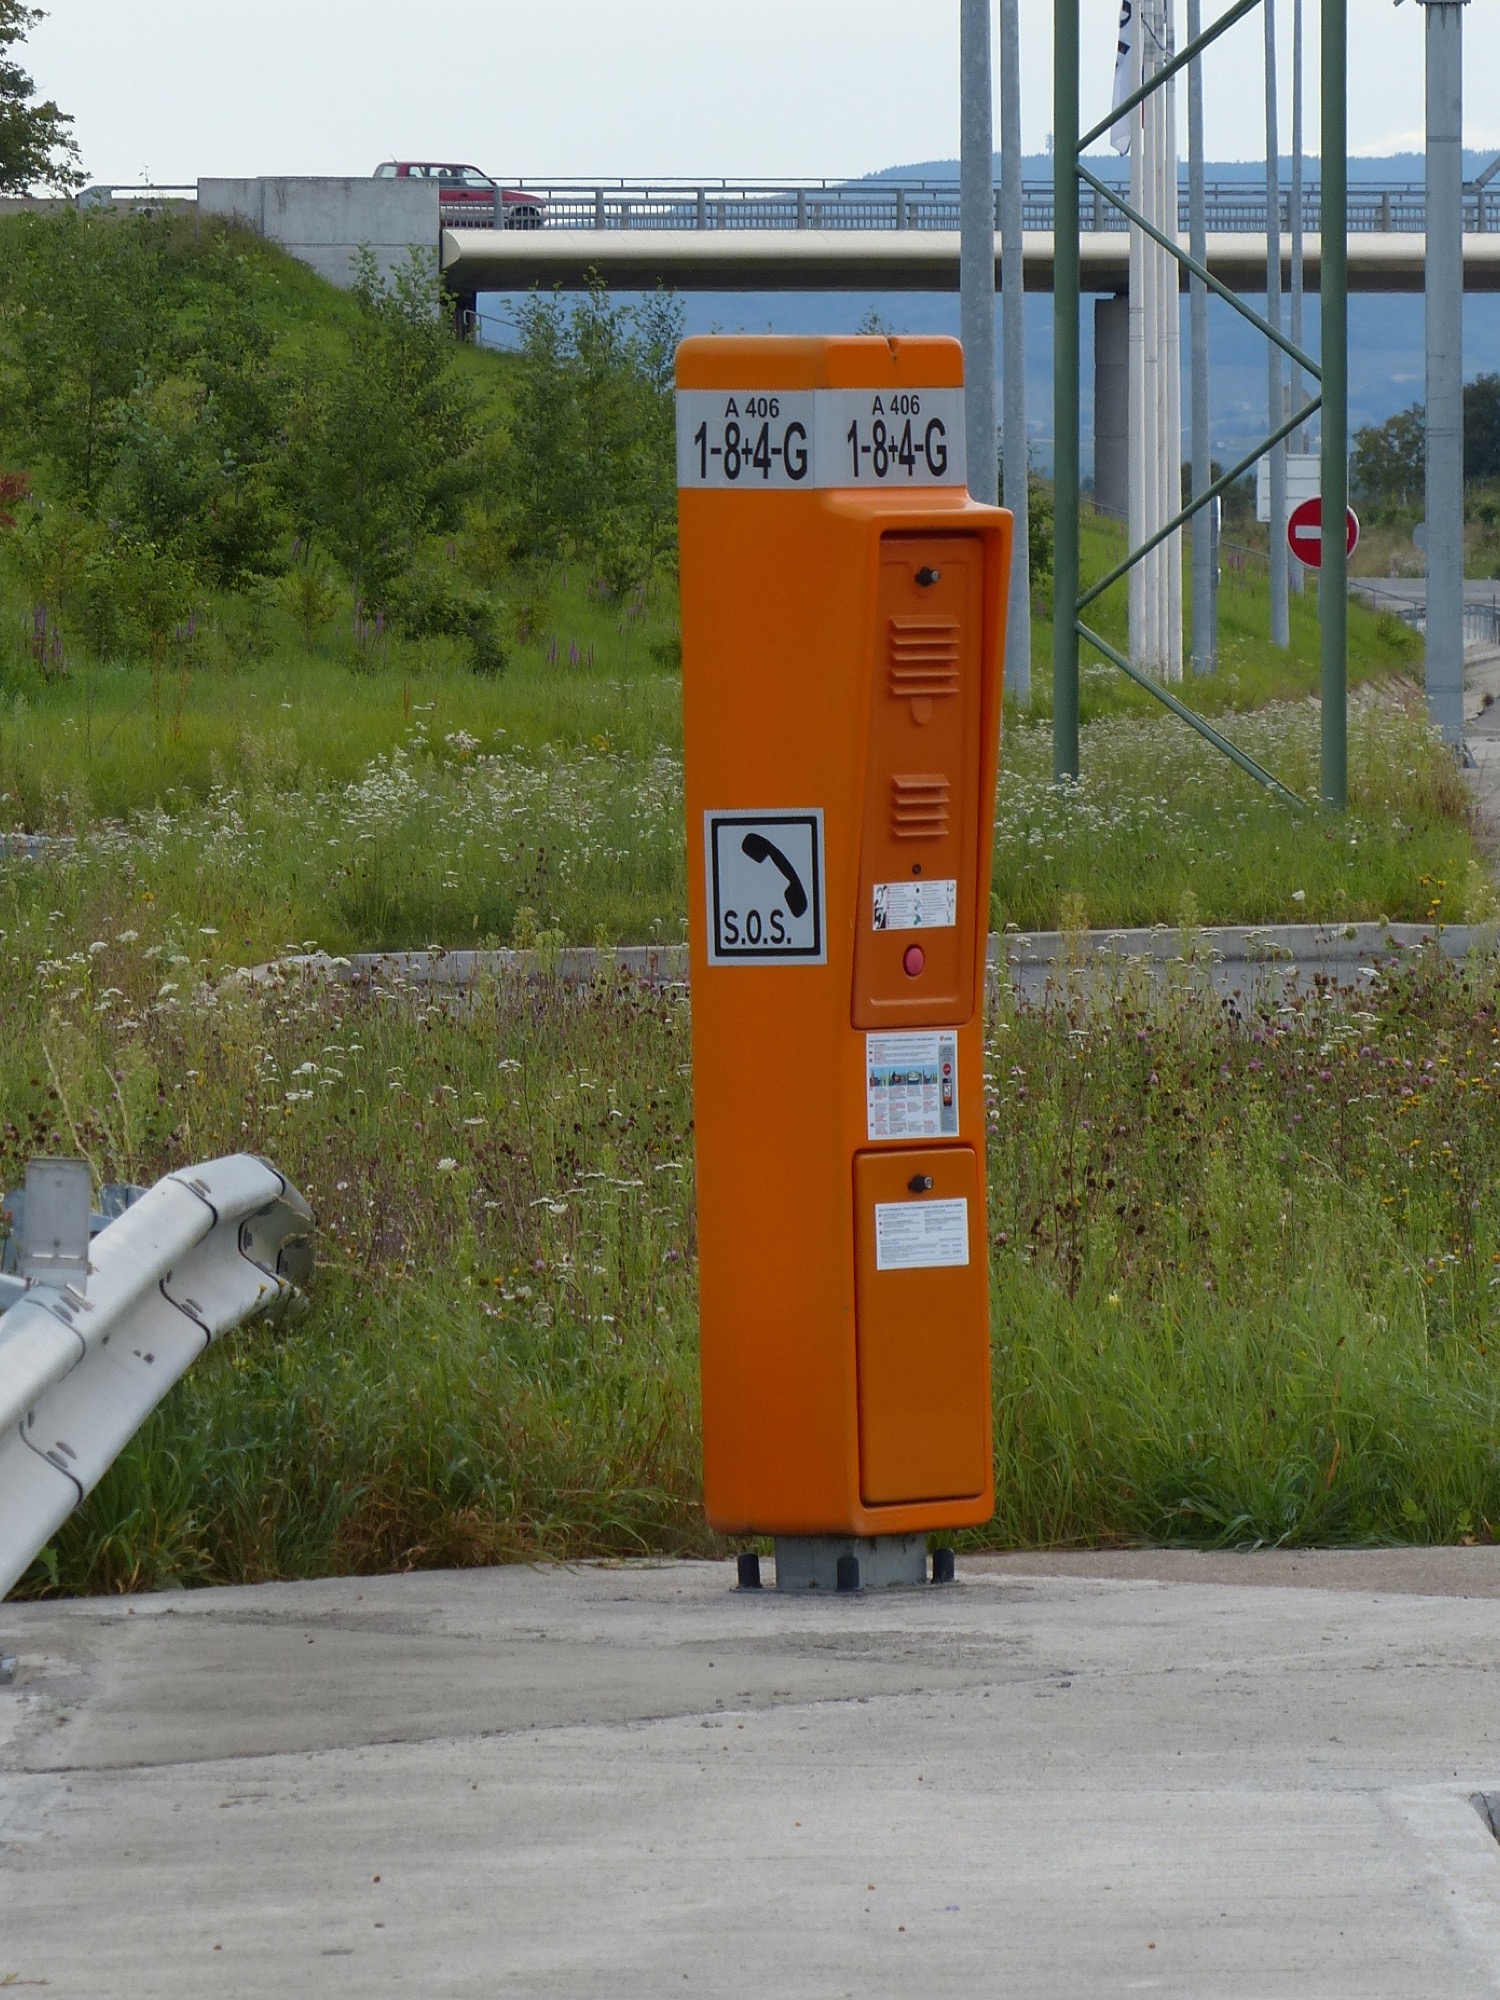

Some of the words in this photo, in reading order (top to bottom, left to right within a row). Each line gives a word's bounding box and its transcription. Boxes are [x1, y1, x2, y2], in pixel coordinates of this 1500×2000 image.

[725, 397, 739, 418] A
[745, 397, 780, 418] 406
[872, 395, 884, 415] A
[890, 395, 920, 415] 406
[694, 421, 807, 481] 1-8+4-G
[847, 418, 947, 478] 1-8+4-G
[724, 909, 792, 945] S.O.S.
